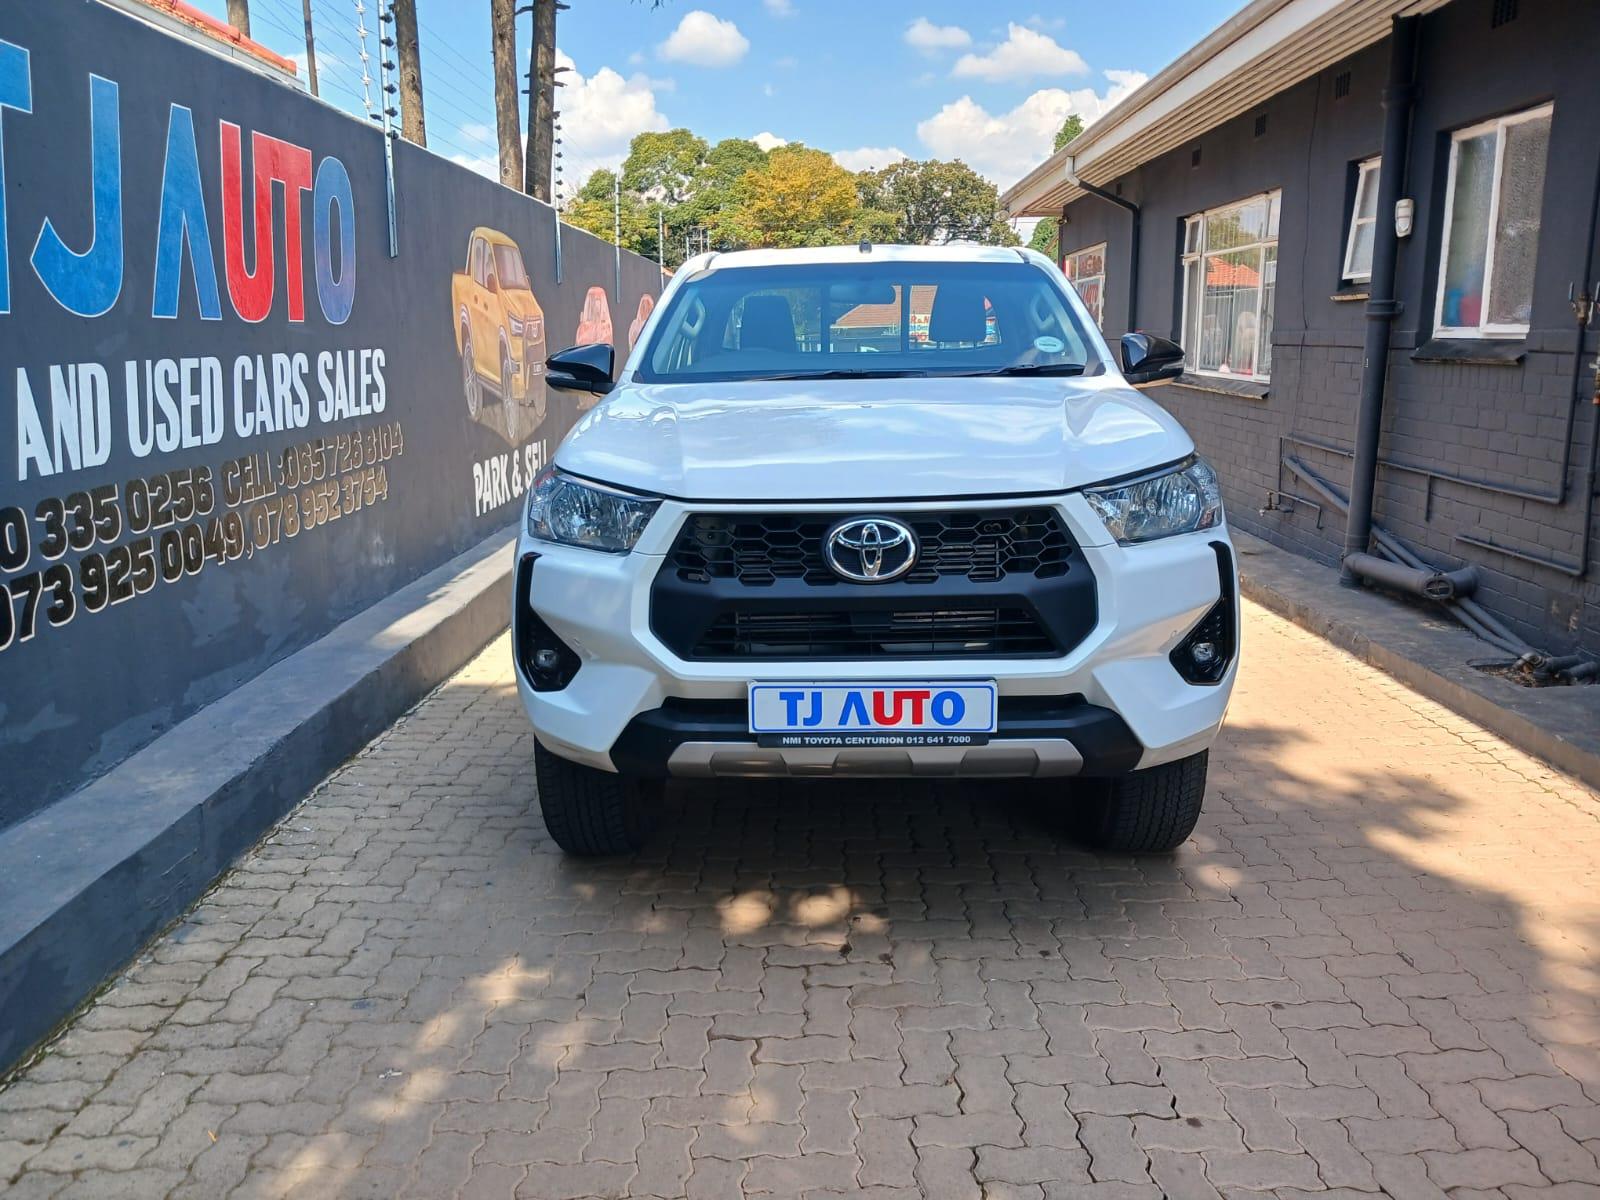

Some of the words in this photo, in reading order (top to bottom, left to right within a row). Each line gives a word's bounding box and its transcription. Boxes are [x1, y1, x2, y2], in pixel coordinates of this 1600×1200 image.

[151, 102, 356, 324] AUTO
[16, 362, 112, 482] AND
[124, 355, 224, 458] USED
[233, 351, 310, 438] CARS
[317, 347, 386, 423] SALES
[35, 483, 123, 561] 335
[125, 464, 215, 535] 0256
[472, 453, 511, 518] PARK
[511, 448, 524, 499] &
[80, 535, 157, 614] 925
[301, 479, 341, 530] 952
[778, 690, 823, 727] TJ
[838, 689, 966, 727] AUTO
[782, 736, 802, 745] NMI
[804, 736, 843, 745] TOYOTA
[845, 736, 904, 745] CENTURION
[906, 735, 925, 744] 012
[926, 735, 945, 744] 641
[947, 735, 971, 744] 7000
